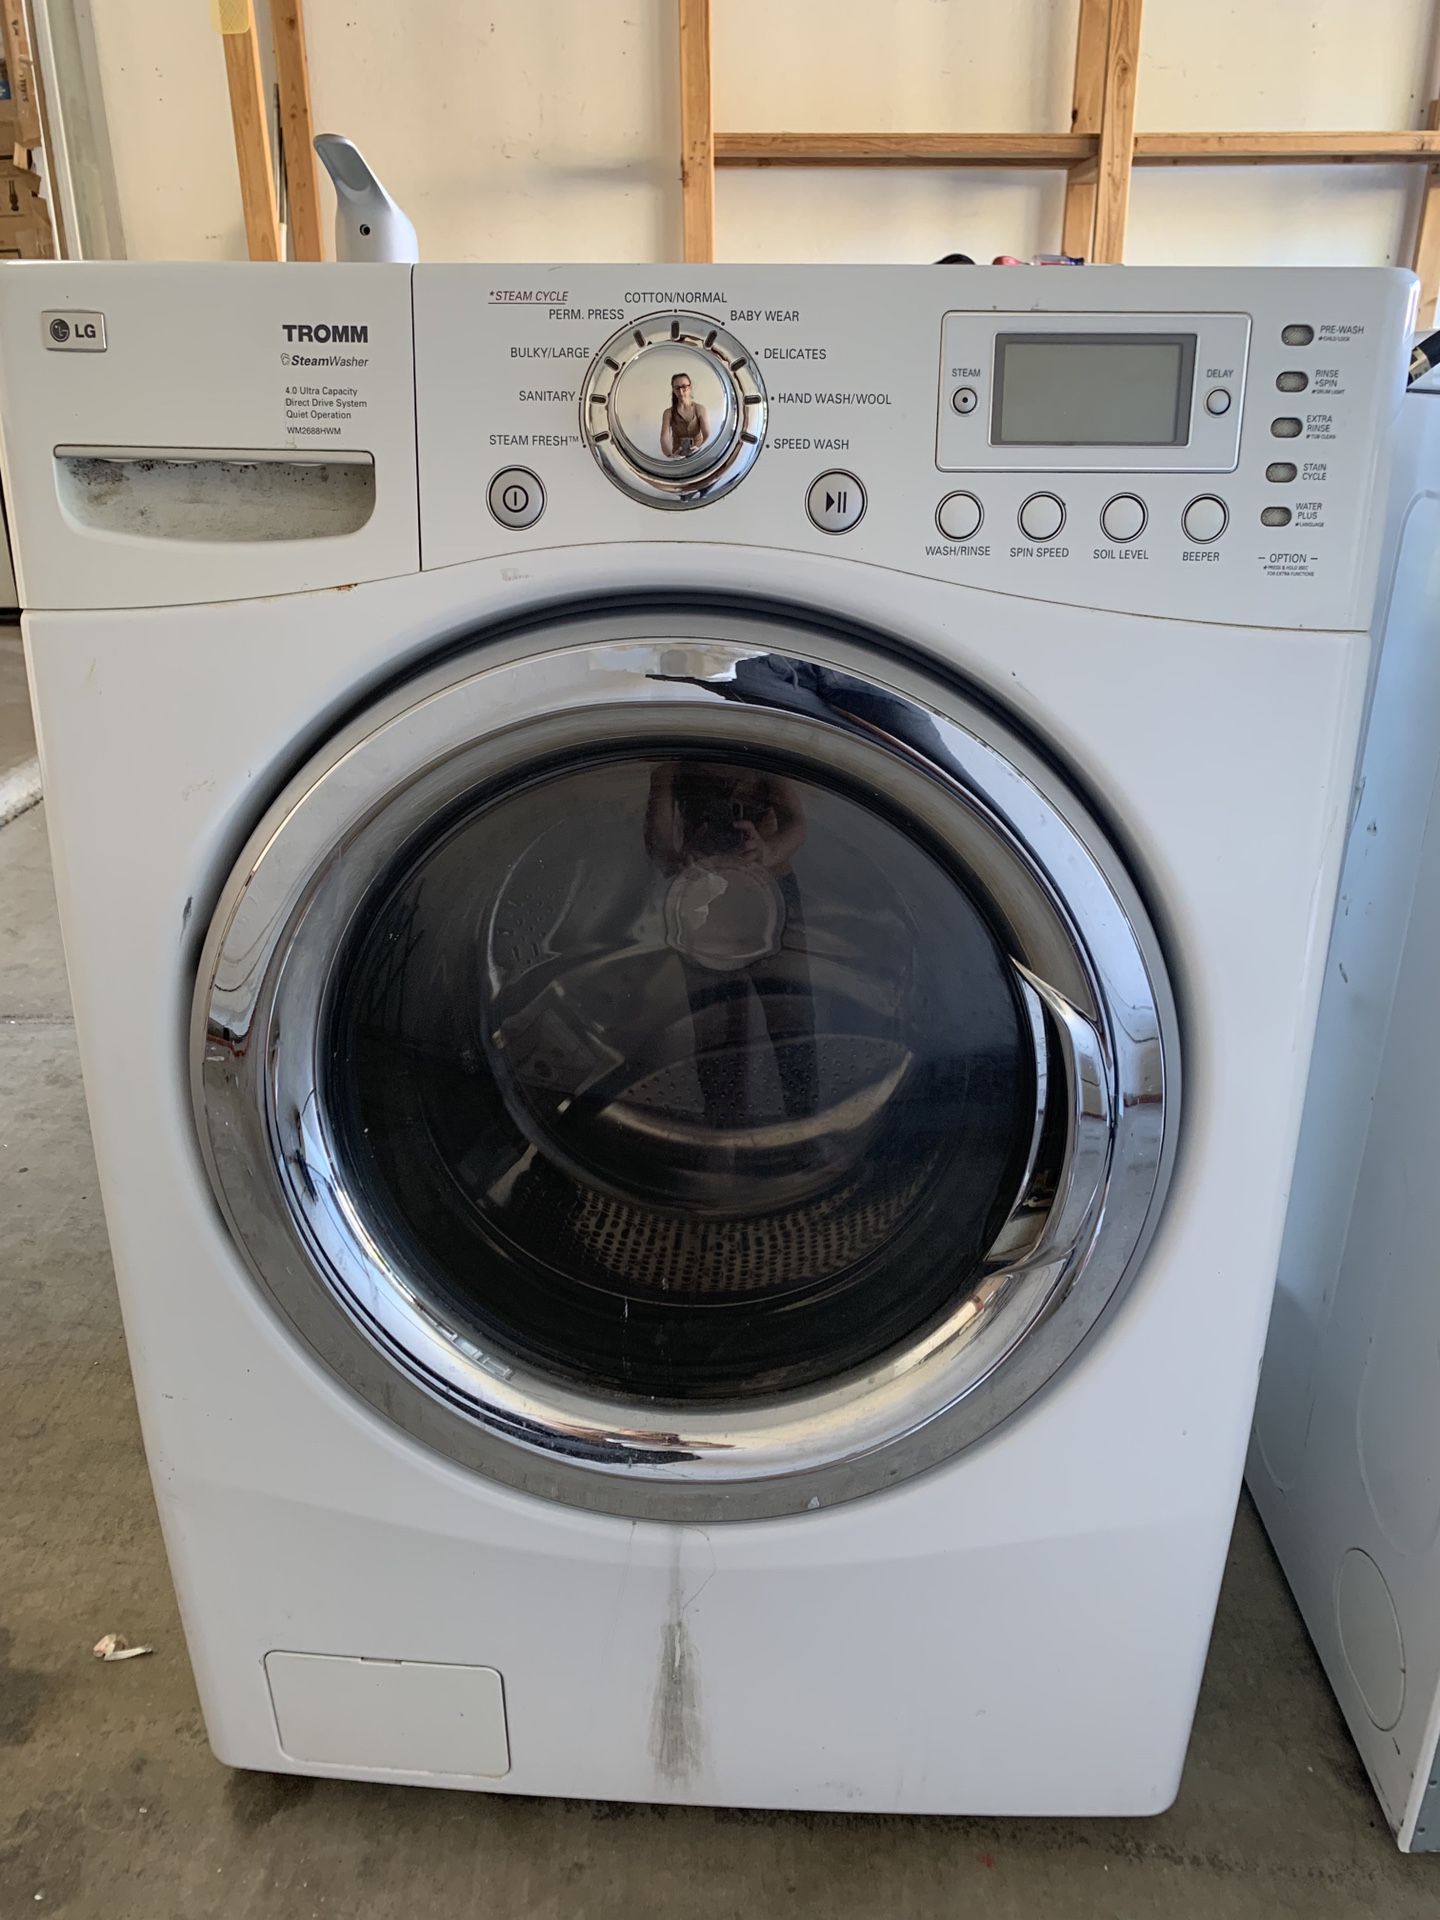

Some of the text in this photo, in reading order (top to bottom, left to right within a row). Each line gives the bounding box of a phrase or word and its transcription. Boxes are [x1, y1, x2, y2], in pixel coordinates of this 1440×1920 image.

[535, 290, 569, 302] CYCLE
[624, 292, 728, 304] COTTON/NORMAL
[548, 309, 625, 320] PERM. PRESS
[730, 310, 800, 322] BABY WEAR
[74, 323, 97, 339] LG
[282, 324, 369, 344] TROMM
[1320, 325, 1365, 335] PRE-WASH
[510, 347, 590, 359] BULKY/LARGE
[763, 348, 827, 360] DELICATES
[951, 368, 981, 378] STEAM
[1206, 368, 1234, 378] DELAY
[1315, 370, 1339, 378] RINSE
[285, 386, 358, 397] 4.0 Ultra Capacity
[518, 390, 576, 402] SANITARY
[285, 398, 368, 409] Direct Drive System
[778, 392, 892, 405] HAND WASH/WOOL
[286, 410, 352, 420] Quiet Operation
[1306, 415, 1333, 424] EXTRA
[1306, 424, 1331, 433] RINSE
[489, 434, 529, 446] STEAM
[774, 438, 850, 450] SPEED WASH
[1303, 463, 1327, 472] STAIN
[1302, 472, 1327, 481] CYCLE
[1295, 502, 1323, 511] WATER
[1297, 511, 1318, 520] PLUS
[925, 545, 991, 557] WASH/RINSE
[1009, 547, 1070, 558] SPIN SPEED
[1093, 549, 1149, 560] SOIL LEVEL
[1182, 551, 1220, 562] BEEPER
[1269, 553, 1307, 564] OPTION
